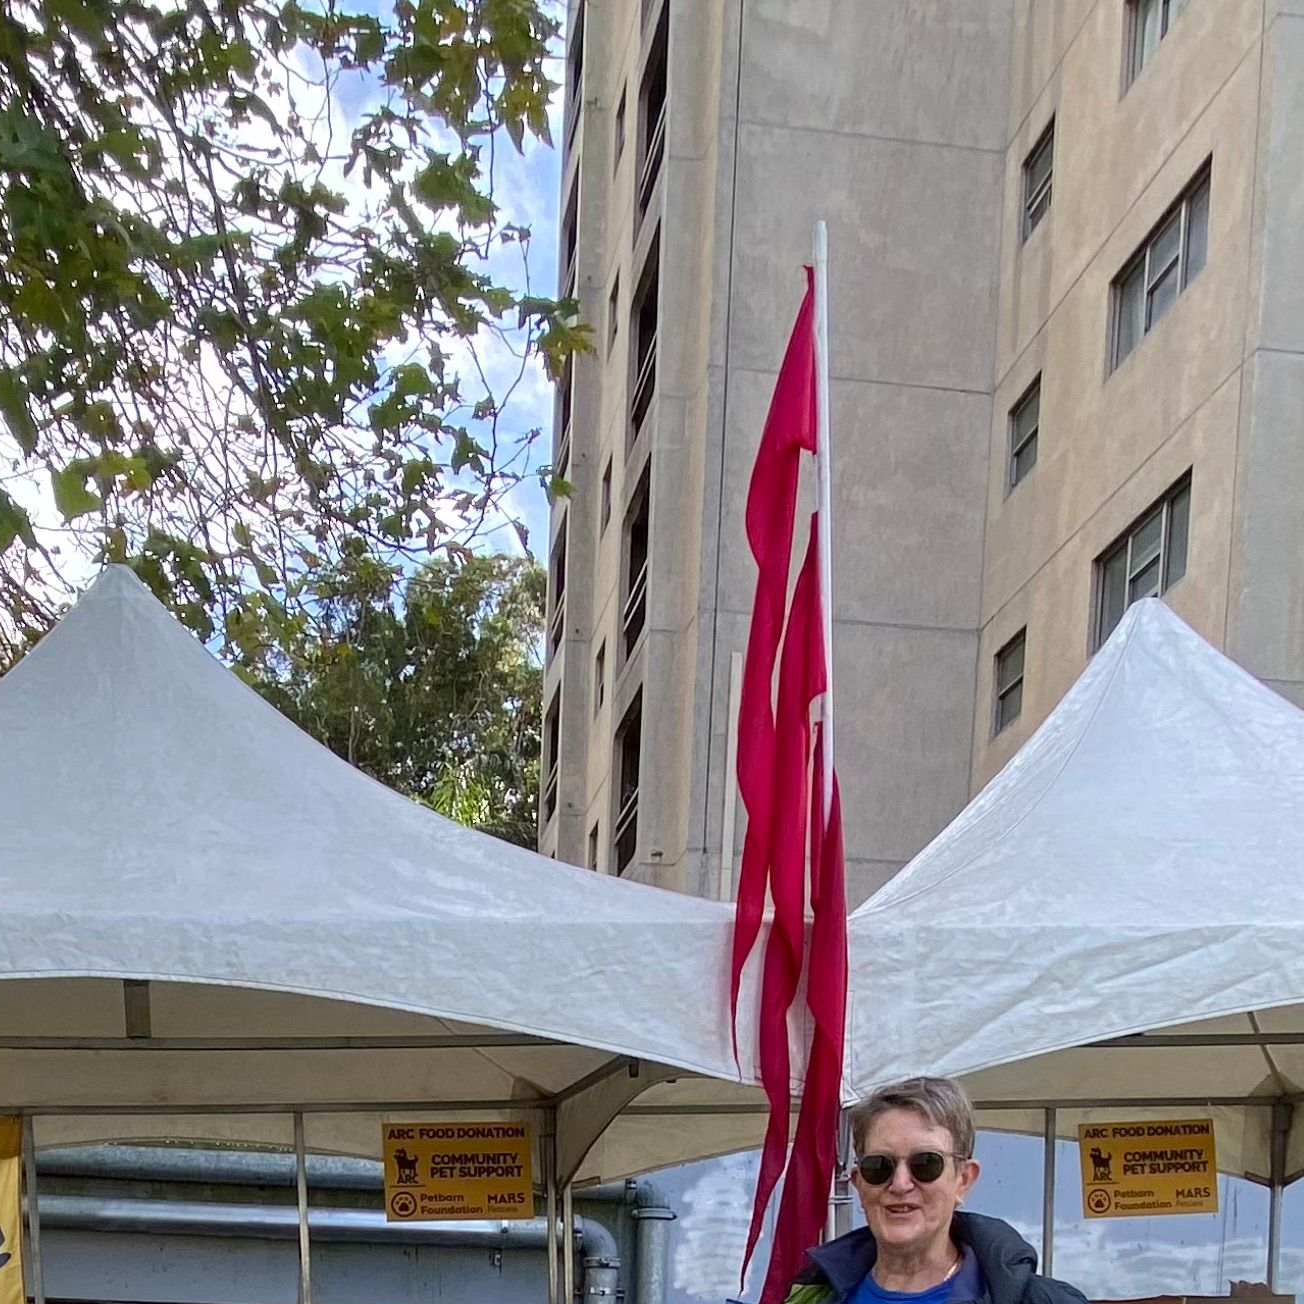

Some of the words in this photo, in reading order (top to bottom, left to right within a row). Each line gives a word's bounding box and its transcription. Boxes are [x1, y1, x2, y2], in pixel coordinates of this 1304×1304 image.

[388, 1129, 415, 1140] ARC
[419, 1127, 454, 1139] FOOD
[457, 1127, 525, 1138] DONATION
[1084, 1128, 1109, 1139] ARC
[1112, 1126, 1144, 1138] FOOD
[1147, 1124, 1210, 1136] DONATION
[431, 1153, 519, 1166] COMMUNITY
[1123, 1149, 1203, 1162] COMMUNITY
[430, 1166, 457, 1179] PET
[458, 1165, 523, 1178] SUPPORT
[1123, 1163, 1146, 1175] PET
[1149, 1161, 1208, 1174] SUPPORT
[397, 1175, 419, 1184] ARC
[420, 1193, 464, 1202] Petbarn
[1114, 1189, 1155, 1198] Petbarn
[1176, 1187, 1211, 1198] MARS
[487, 1193, 525, 1204] MARS
[421, 1205, 483, 1215] Foundation
[1114, 1201, 1172, 1210] Foundation
